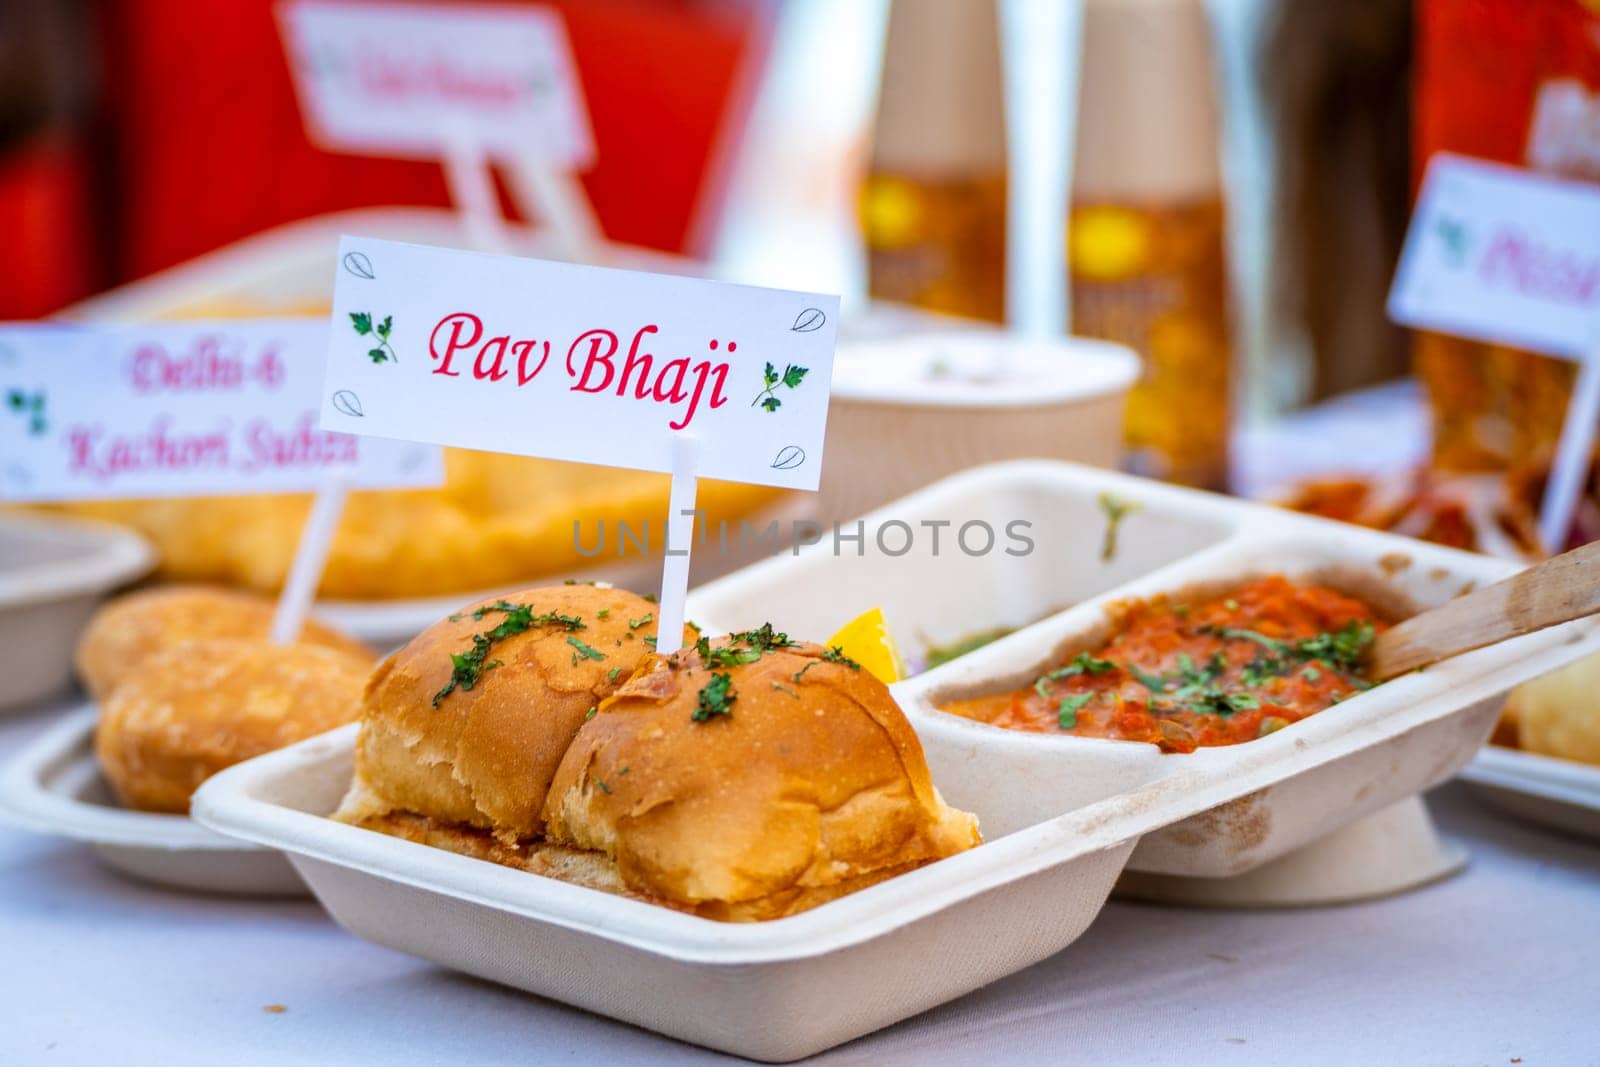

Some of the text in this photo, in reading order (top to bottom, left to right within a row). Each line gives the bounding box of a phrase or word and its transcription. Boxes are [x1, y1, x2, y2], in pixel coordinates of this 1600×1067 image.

[130, 336, 285, 390] Delhi-6
[429, 312, 737, 430] Pav Bhaji
[66, 414, 230, 481] Kachori
